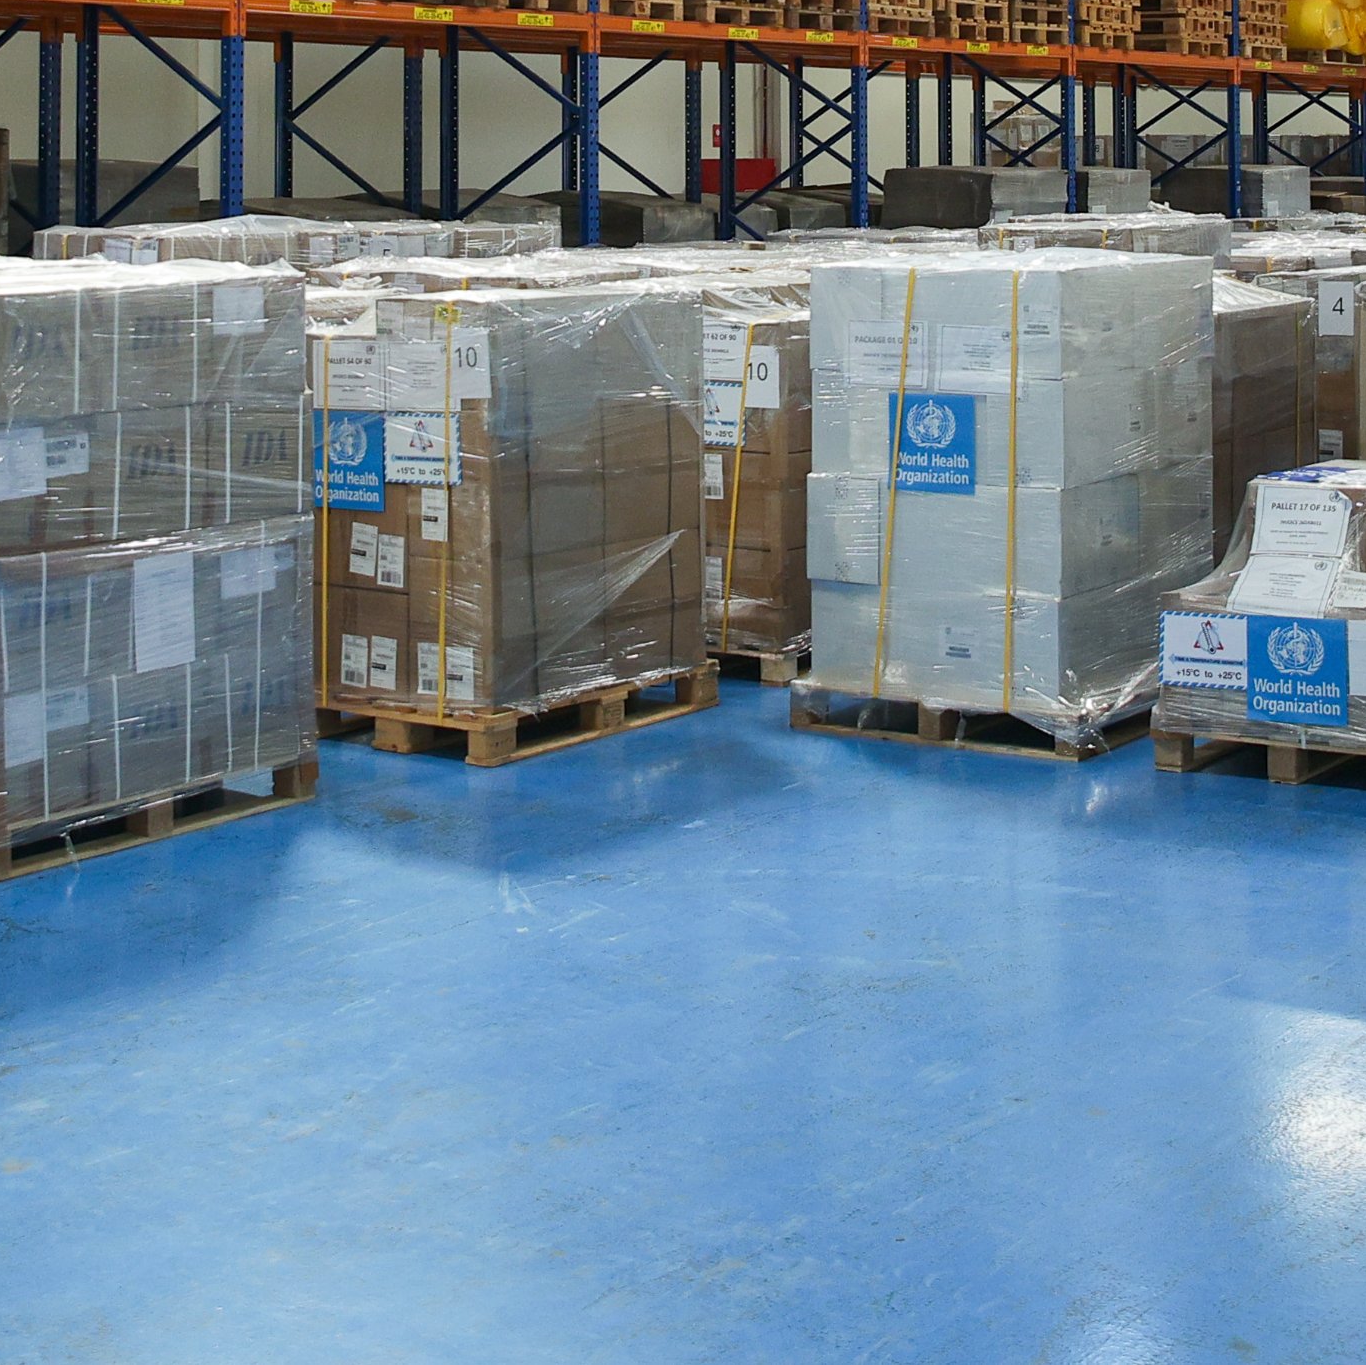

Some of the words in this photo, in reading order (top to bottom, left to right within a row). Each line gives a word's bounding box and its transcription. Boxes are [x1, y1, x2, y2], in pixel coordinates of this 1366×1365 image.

[1332, 297, 1344, 315] 4
[455, 347, 477, 367] 10
[748, 363, 768, 381] 10
[898, 452, 927, 466] World
[932, 454, 969, 467] Health
[347, 472, 378, 486] Health
[895, 469, 969, 485] Organization
[315, 486, 379, 502] Oganization
[1176, 669, 1200, 677] +15°C
[1205, 670, 1213, 678] to
[1218, 672, 1242, 680] +25°C
[1254, 679, 1291, 694] World
[1297, 681, 1340, 698] Health
[1253, 696, 1340, 716] Organization
